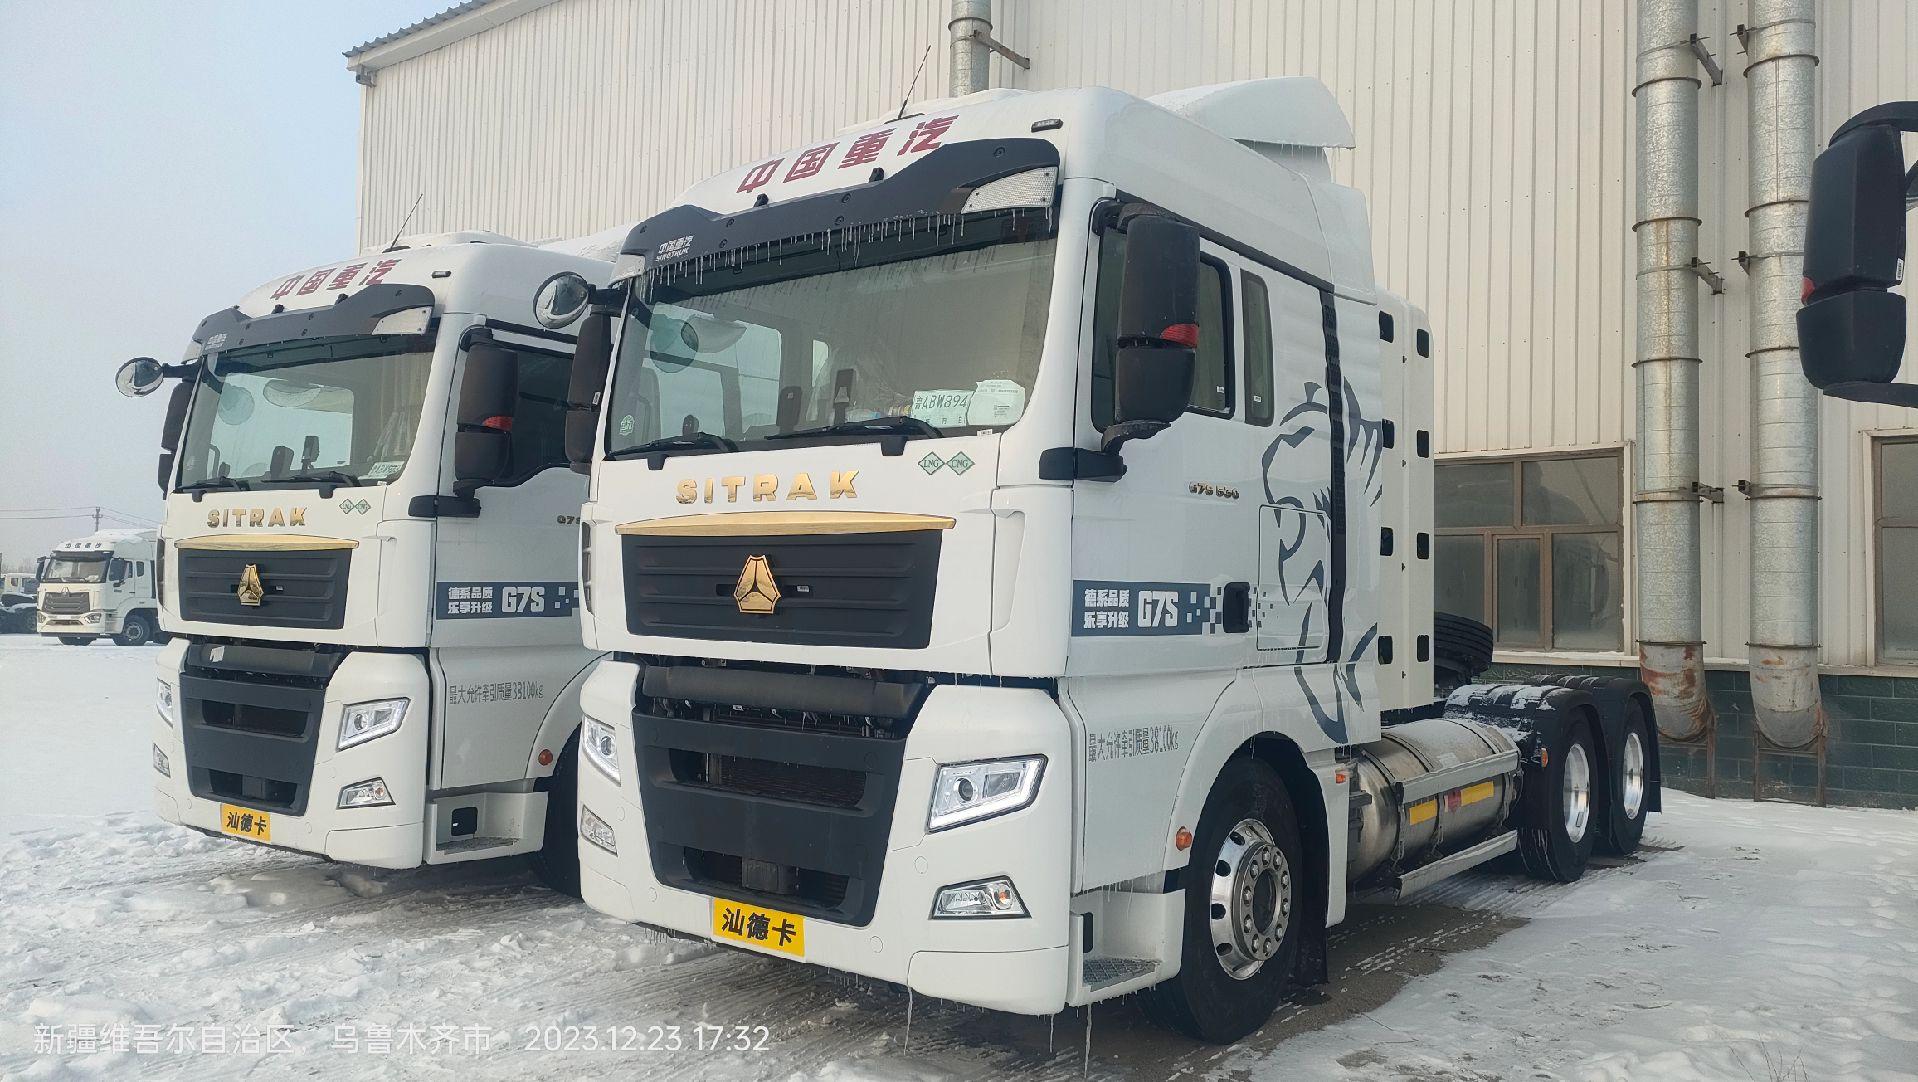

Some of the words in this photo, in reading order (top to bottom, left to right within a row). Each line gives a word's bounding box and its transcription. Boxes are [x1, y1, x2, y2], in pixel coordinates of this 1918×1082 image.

[735, 114, 960, 194] 中国重汽
[269, 258, 402, 300] 中国重汽
[951, 460, 968, 468] CNG
[675, 469, 860, 505] SITRAK
[206, 506, 307, 528] SITRAK
[448, 586, 493, 600] 德系品质
[501, 586, 545, 613] G7S
[1084, 588, 1130, 608] 德系品质
[447, 601, 493, 614] 乐享升级
[1083, 611, 1129, 629] 乐享升级
[1137, 590, 1179, 628] G7S
[226, 811, 267, 836] 汕德卡
[721, 907, 797, 947] 汕德卡
